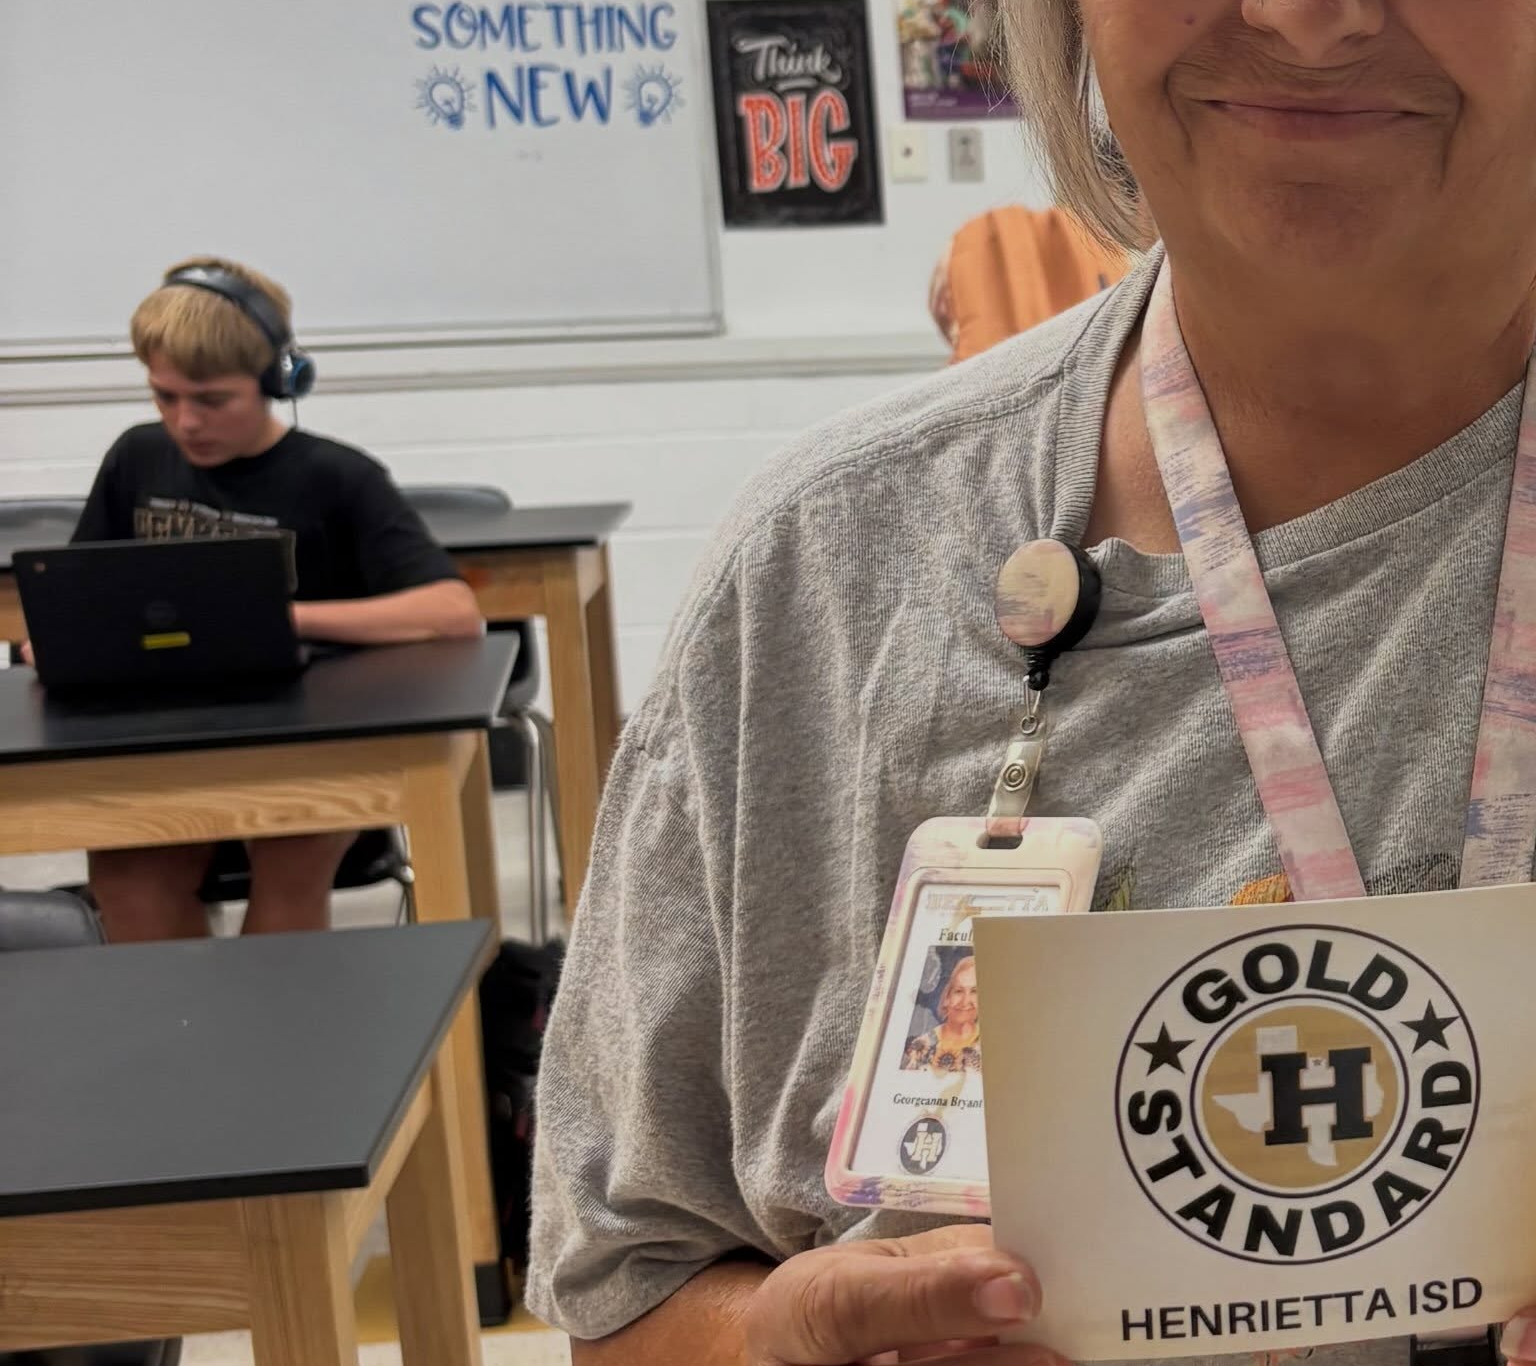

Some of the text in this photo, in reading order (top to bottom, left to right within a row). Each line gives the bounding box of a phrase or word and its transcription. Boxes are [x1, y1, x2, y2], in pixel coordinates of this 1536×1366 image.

[411, 0, 678, 56] SOMETHING
[735, 36, 842, 82] Think
[486, 63, 612, 130] NEW
[736, 88, 859, 193] BIG
[938, 928, 975, 943] Facul
[1181, 938, 1410, 1026] GOLD
[892, 1092, 983, 1110] Georgeanna Bryant
[1261, 1046, 1374, 1147] H
[1127, 1059, 1474, 1259] STANDARD
[1121, 1275, 1484, 1342] HENRIETTA ISD
